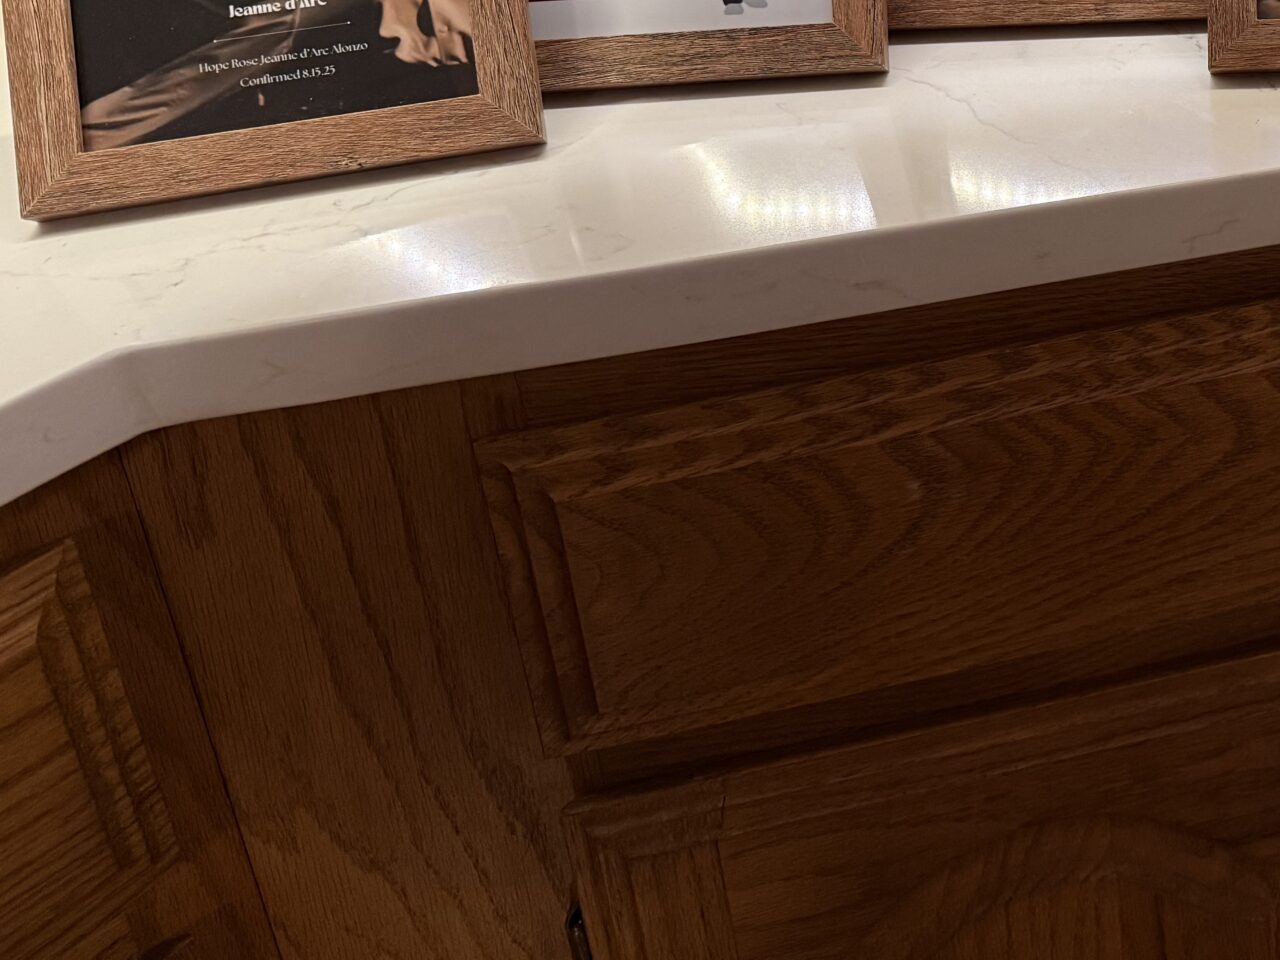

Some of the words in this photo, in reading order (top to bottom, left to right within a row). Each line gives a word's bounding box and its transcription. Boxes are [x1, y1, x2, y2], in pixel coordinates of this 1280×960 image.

[229, 2, 281, 19] Jeanne
[199, 62, 230, 74] Hope
[231, 58, 259, 69] Rose
[260, 53, 298, 66] Jeanne
[329, 41, 369, 55] Alonzo
[240, 69, 301, 88] Confirmed
[302, 64, 336, 79] 8.15.25
